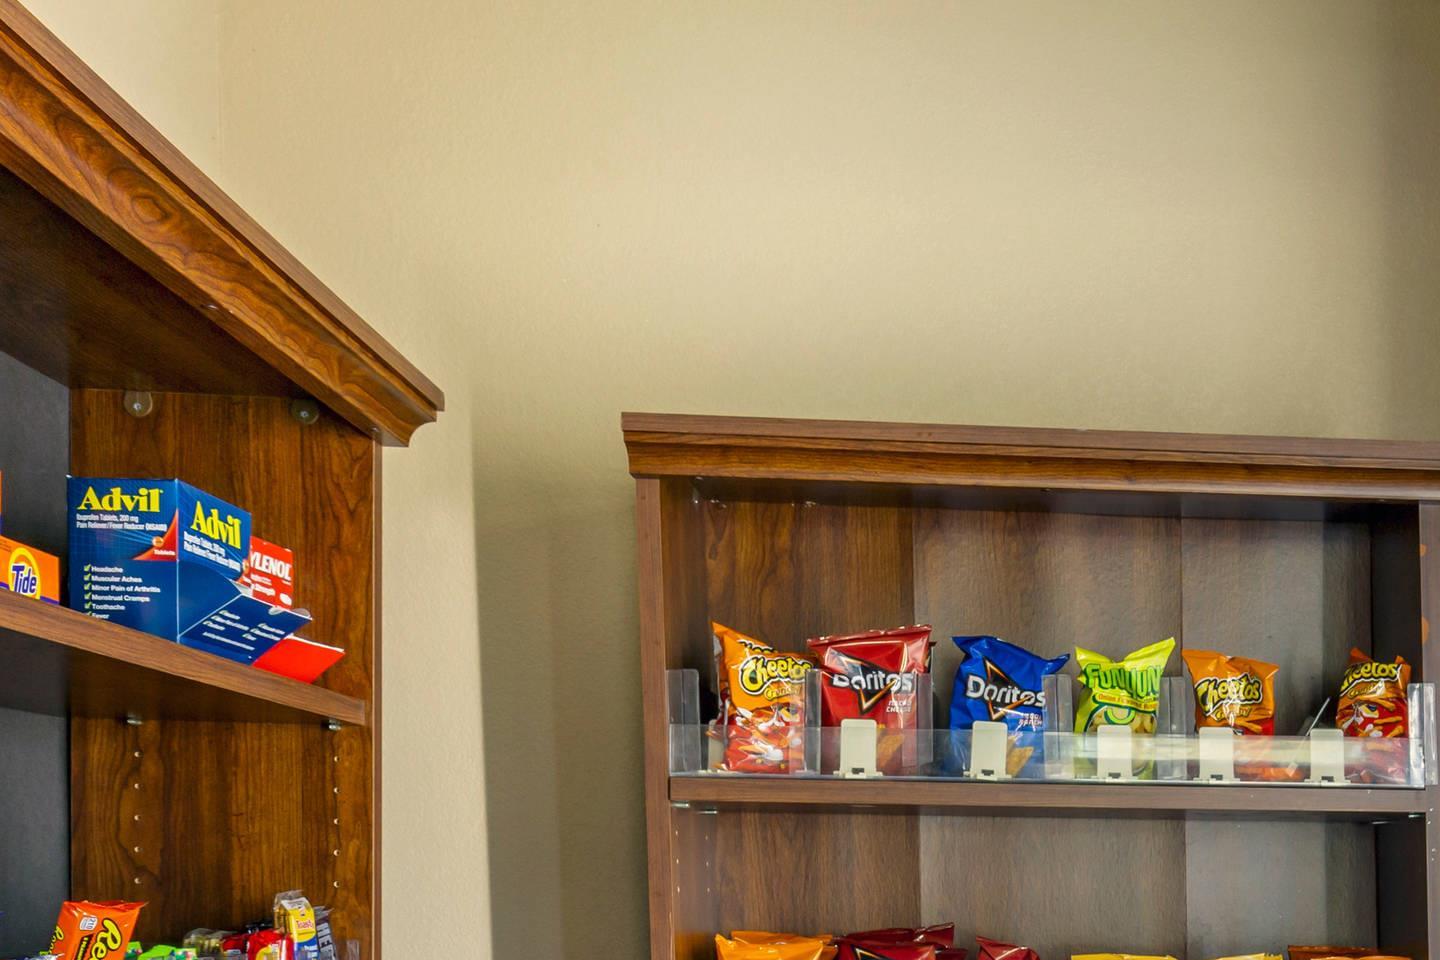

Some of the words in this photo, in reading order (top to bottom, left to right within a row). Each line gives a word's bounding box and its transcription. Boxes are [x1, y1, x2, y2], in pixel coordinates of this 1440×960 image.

[76, 486, 160, 512] Advil
[190, 500, 242, 549] Advil
[11, 564, 37, 594] Tide
[91, 575, 121, 583] Muscular
[121, 575, 143, 583] Aches
[250, 551, 292, 580] YLENOL
[739, 654, 813, 695] Cheetos
[832, 672, 915, 691] Doritos
[1085, 664, 1162, 699] FUNYUN
[966, 674, 1046, 708] Doritos
[1196, 674, 1262, 714] Cheetos
